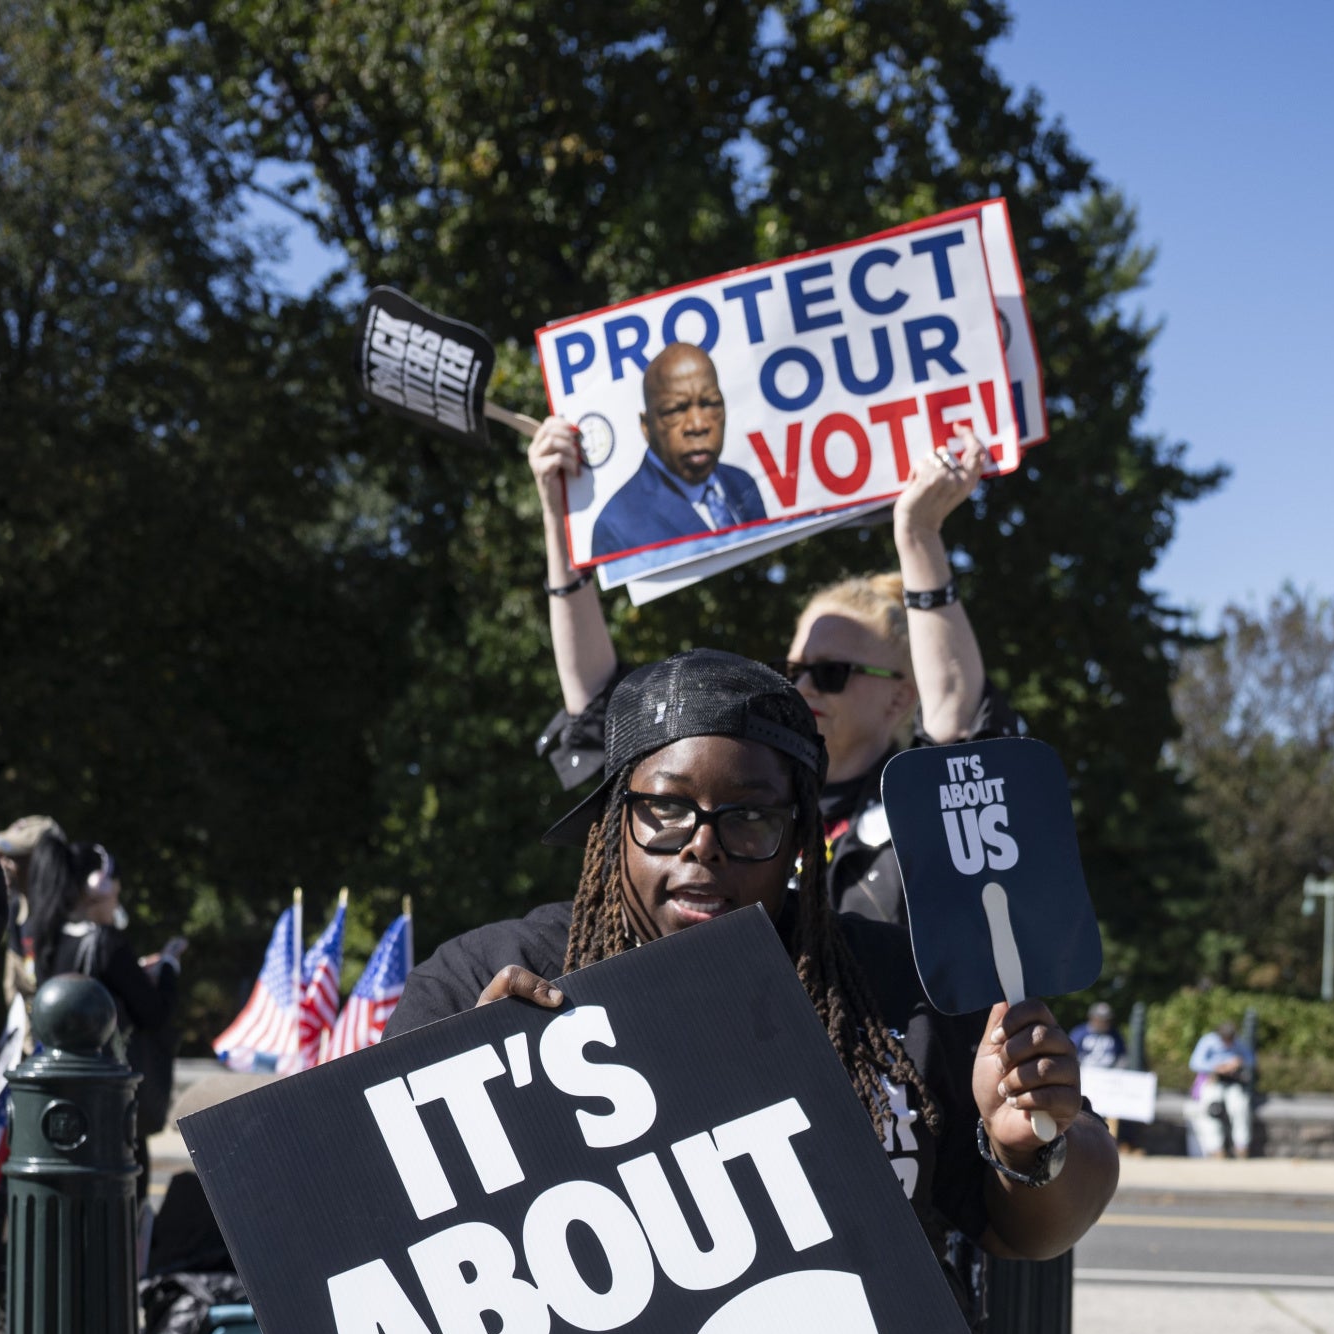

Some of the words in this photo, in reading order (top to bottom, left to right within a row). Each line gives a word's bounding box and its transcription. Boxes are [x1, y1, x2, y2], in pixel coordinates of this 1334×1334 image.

[556, 230, 965, 395] PROTECT
[759, 315, 966, 411] OUR
[747, 380, 1004, 508] VOTE!
[940, 778, 1005, 809] ABOUT
[946, 754, 984, 782] IT'S
[942, 803, 1019, 876] US
[364, 1005, 657, 1221] IT'S
